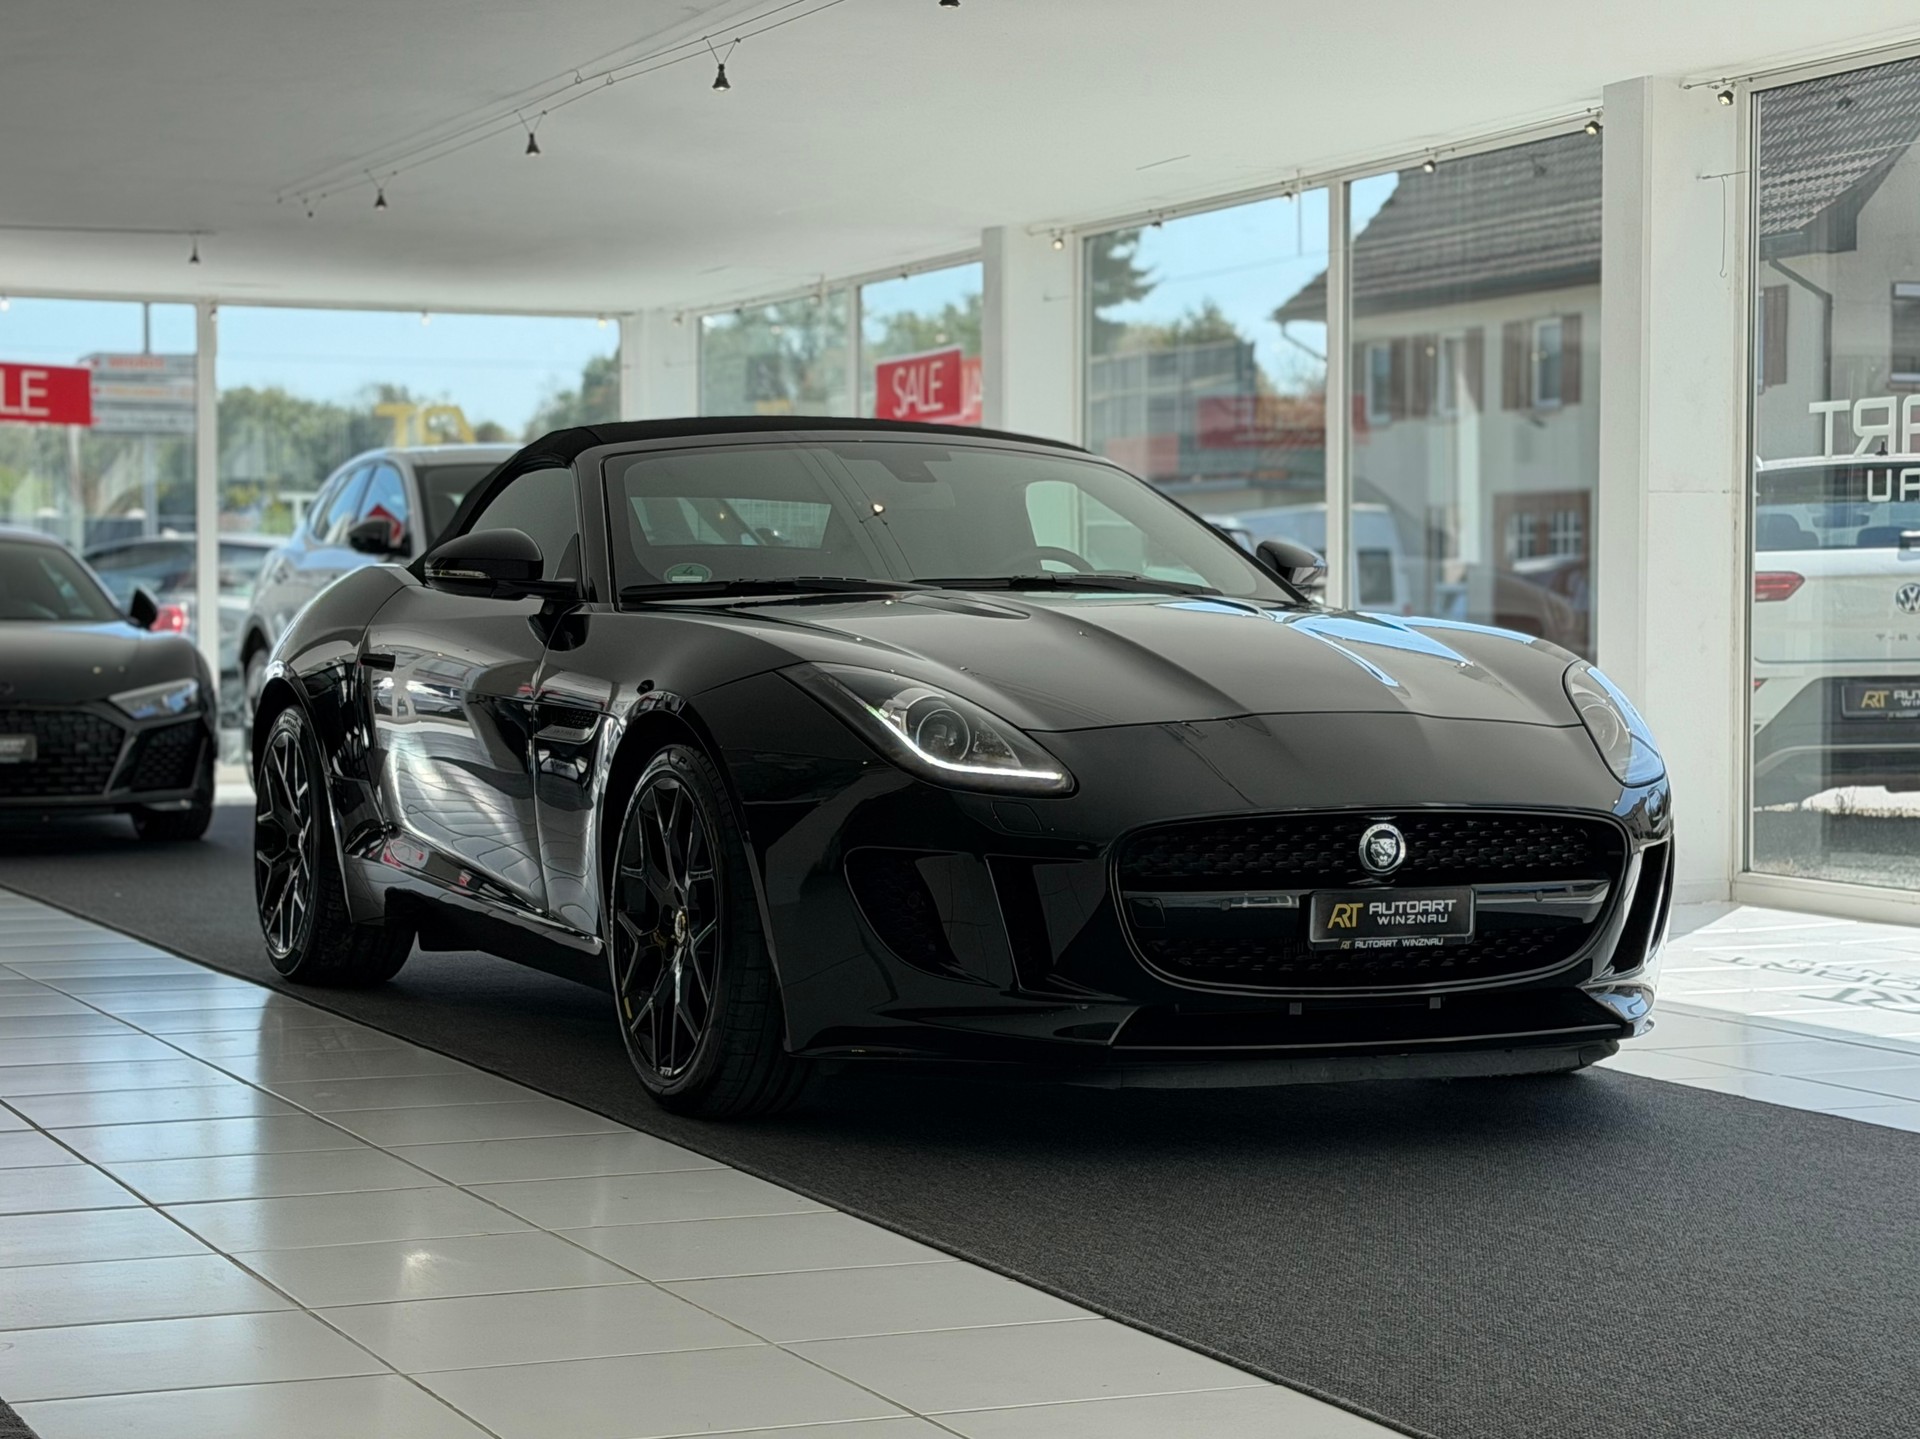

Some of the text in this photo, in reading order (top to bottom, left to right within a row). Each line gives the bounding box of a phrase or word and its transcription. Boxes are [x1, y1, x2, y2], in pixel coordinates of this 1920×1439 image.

[892, 360, 945, 418] SALE
[1369, 900, 1457, 915] AUTOART
[1377, 914, 1448, 925] WINZNAU
[1355, 939, 1398, 949] AUTOART
[1402, 938, 1444, 947] WINZNAU
